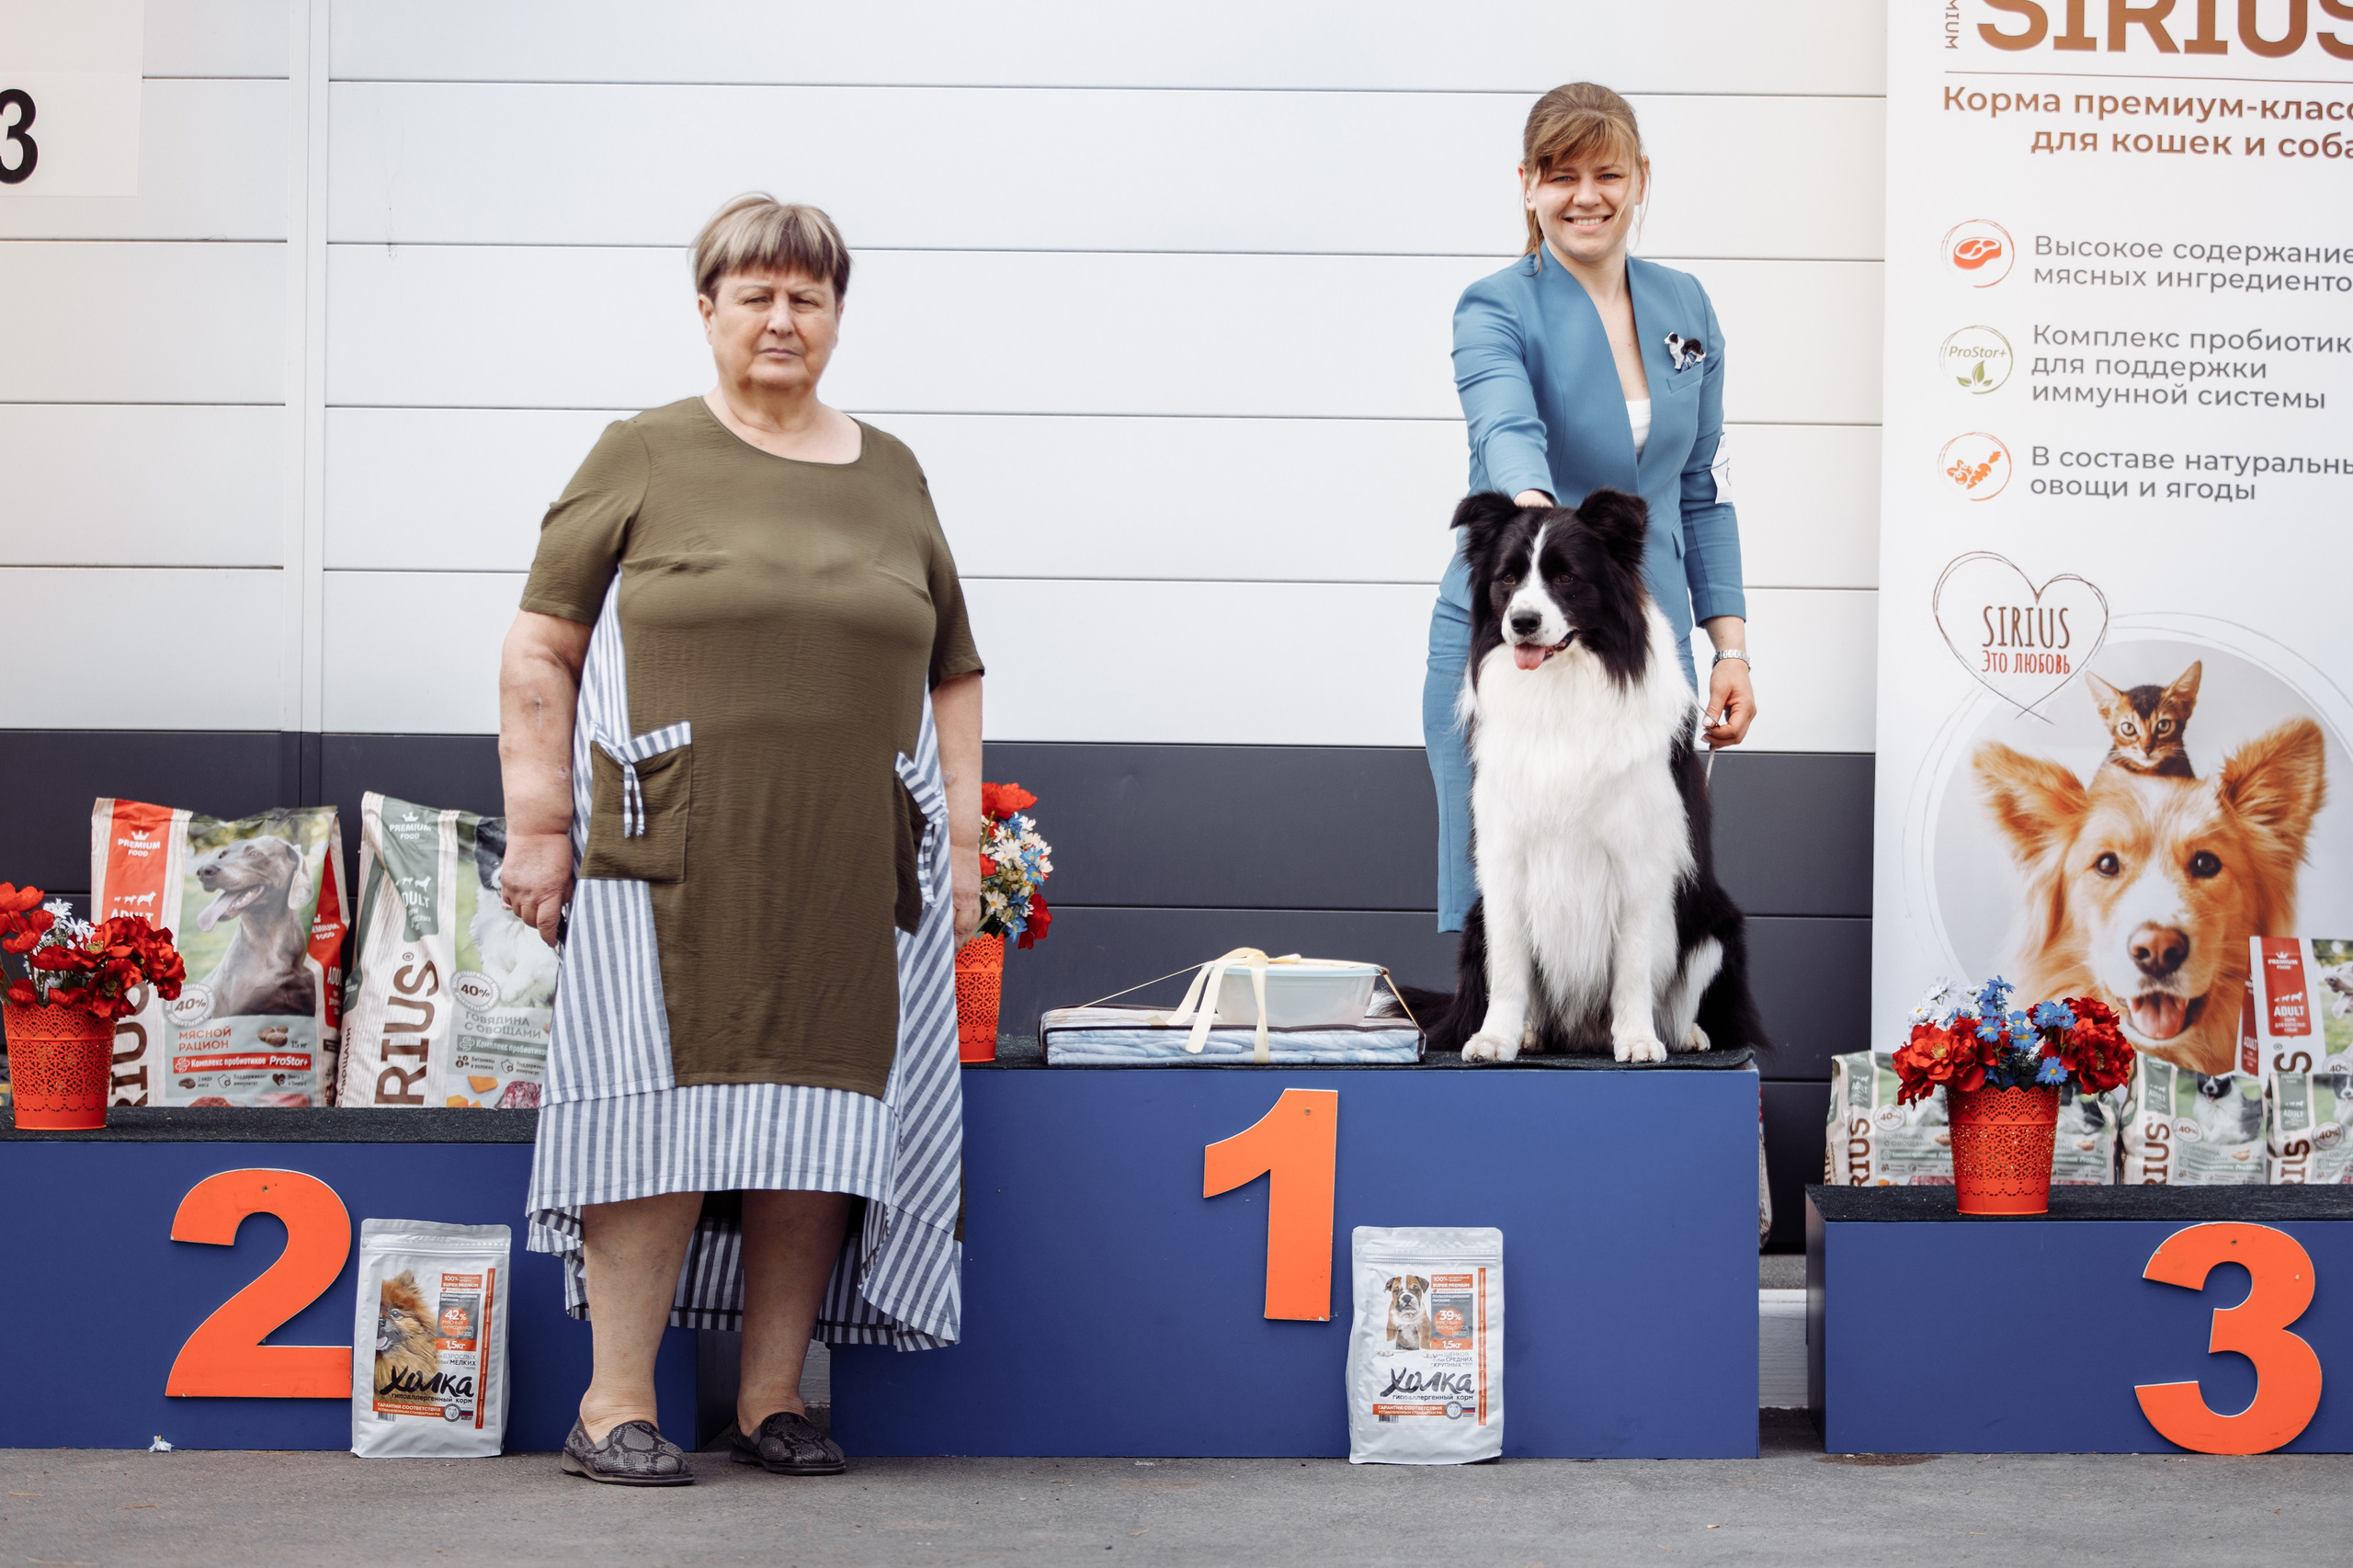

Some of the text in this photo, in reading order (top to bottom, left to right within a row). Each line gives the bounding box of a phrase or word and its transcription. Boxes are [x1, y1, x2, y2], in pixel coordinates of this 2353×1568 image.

[1943, 85, 2062, 118] Корма
[0, 88, 39, 185] 3
[2030, 131, 2097, 154] для
[2112, 133, 2233, 155] кошек
[2245, 136, 2265, 156] и
[2035, 235, 2353, 267] Высокое содержание
[2034, 268, 2353, 293] мясных ингредиенто
[2033, 324, 2353, 356] Комплекс пробиотик
[1949, 346, 2007, 358] ProStor+
[2031, 356, 2267, 381] для поддержки
[2032, 383, 2326, 410] иммунной системы
[2031, 446, 2051, 466] В
[2059, 449, 2175, 470] составе
[2029, 479, 2256, 503] овощи и ягоды
[1982, 606, 2071, 649] SIRIUS
[389, 824, 432, 833] PREMIUM
[118, 838, 161, 850] PREMIUM
[128, 849, 149, 858] FOOD
[315, 931, 335, 940] FOOD
[460, 983, 490, 998] 40%
[174, 997, 207, 1013] 40%
[2274, 1006, 2304, 1017] ADULT
[466, 1011, 529, 1027] ГОВЯДИНА
[178, 1026, 232, 1040] МЯСНОЙ
[464, 1021, 541, 1040] С ОВОЩАМИ
[178, 1040, 229, 1052] РАЦИОН
[291, 1040, 300, 1049] 15
[476, 1040, 547, 1056] Комплекс пробиотико
[190, 1055, 308, 1068] Комплекс пробиотиков ProStor+
[2329, 1063, 2348, 1073] 40%
[2283, 1109, 2303, 1118] ADULT
[2178, 1126, 2198, 1135] 40%
[2319, 1129, 2339, 1140] 40%
[1203, 1088, 1338, 1322] 1
[165, 1167, 353, 1399] 2
[445, 1309, 467, 1321] 42%
[1439, 1310, 1461, 1321] 39%
[446, 1340, 466, 1349] 1,5кг
[1442, 1340, 1462, 1350] 1,5кг
[2134, 1221, 2323, 1456] 3
[392, 1392, 453, 1403] гипоаллергенный
[1392, 1393, 1454, 1402] гипоаллергенный
